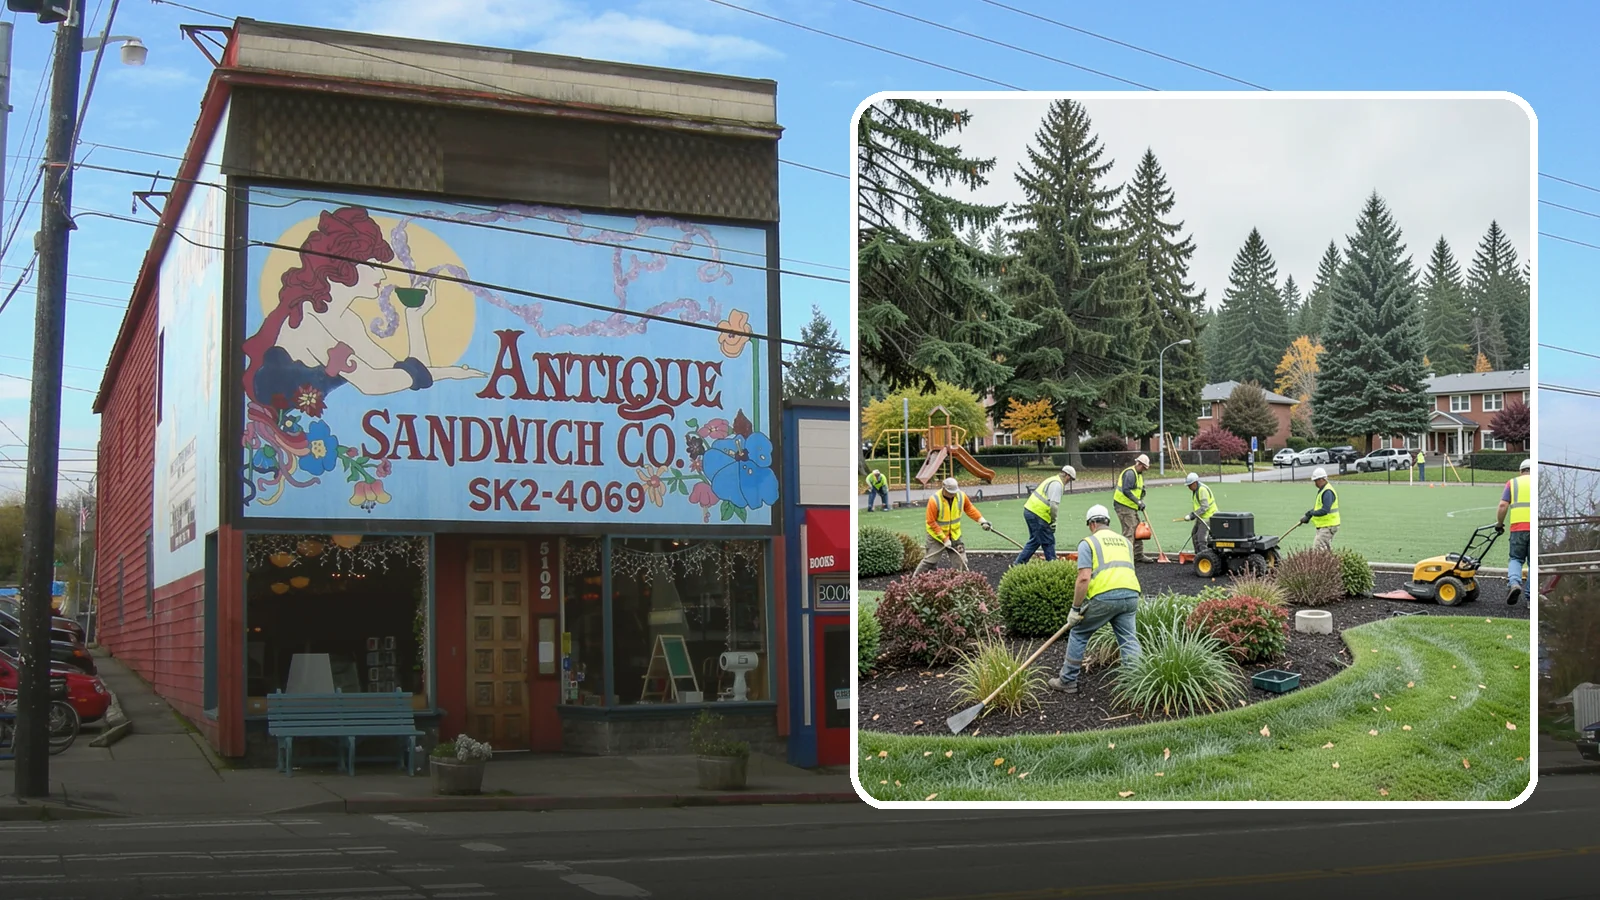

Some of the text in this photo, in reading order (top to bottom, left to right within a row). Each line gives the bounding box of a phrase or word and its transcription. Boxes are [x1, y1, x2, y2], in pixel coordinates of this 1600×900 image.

[475, 329, 724, 421] ANTIQUE
[361, 408, 685, 469] SANDWICH CO.
[468, 477, 646, 513] SK2-4069
[539, 541, 552, 600] 5102
[809, 555, 835, 569] BOOKS
